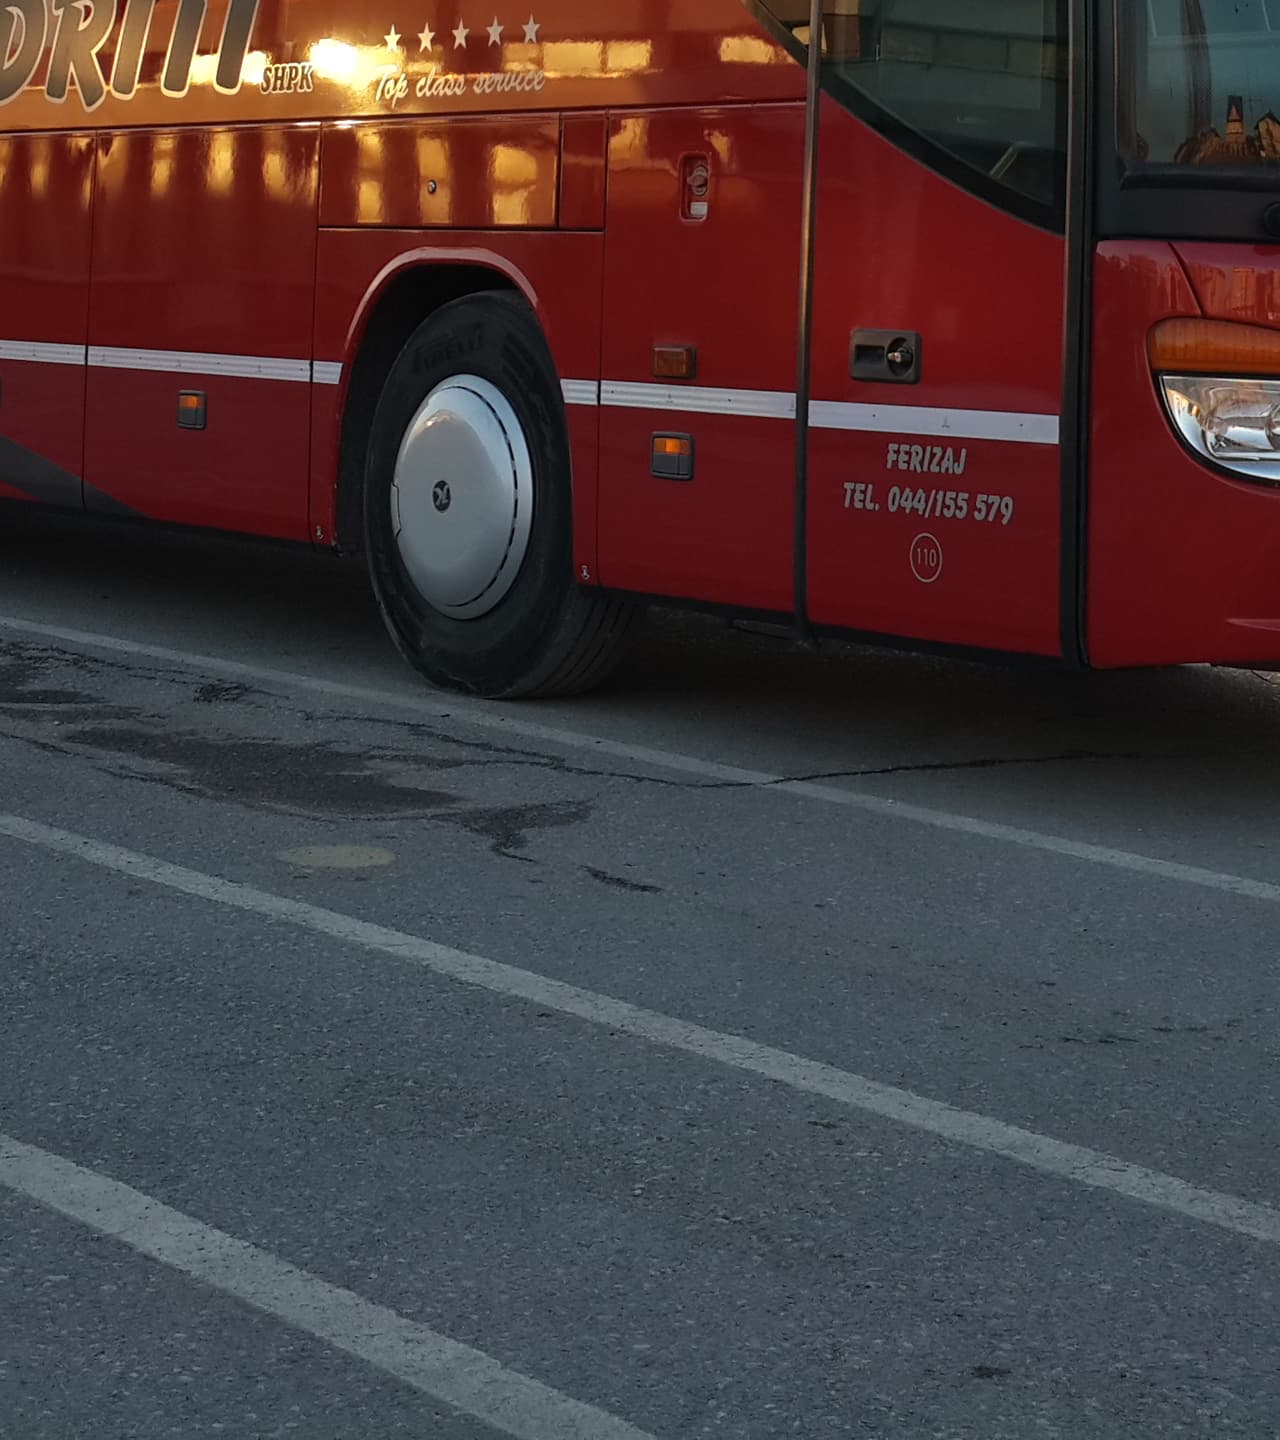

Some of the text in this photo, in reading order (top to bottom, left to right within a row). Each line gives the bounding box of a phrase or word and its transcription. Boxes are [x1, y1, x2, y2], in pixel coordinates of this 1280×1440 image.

[260, 63, 313, 94] SHPK
[375, 66, 545, 108] Top class service
[886, 443, 967, 475] FERIZAJ
[843, 482, 1014, 525] TEL. 044/155 579
[916, 548, 937, 567] 110
